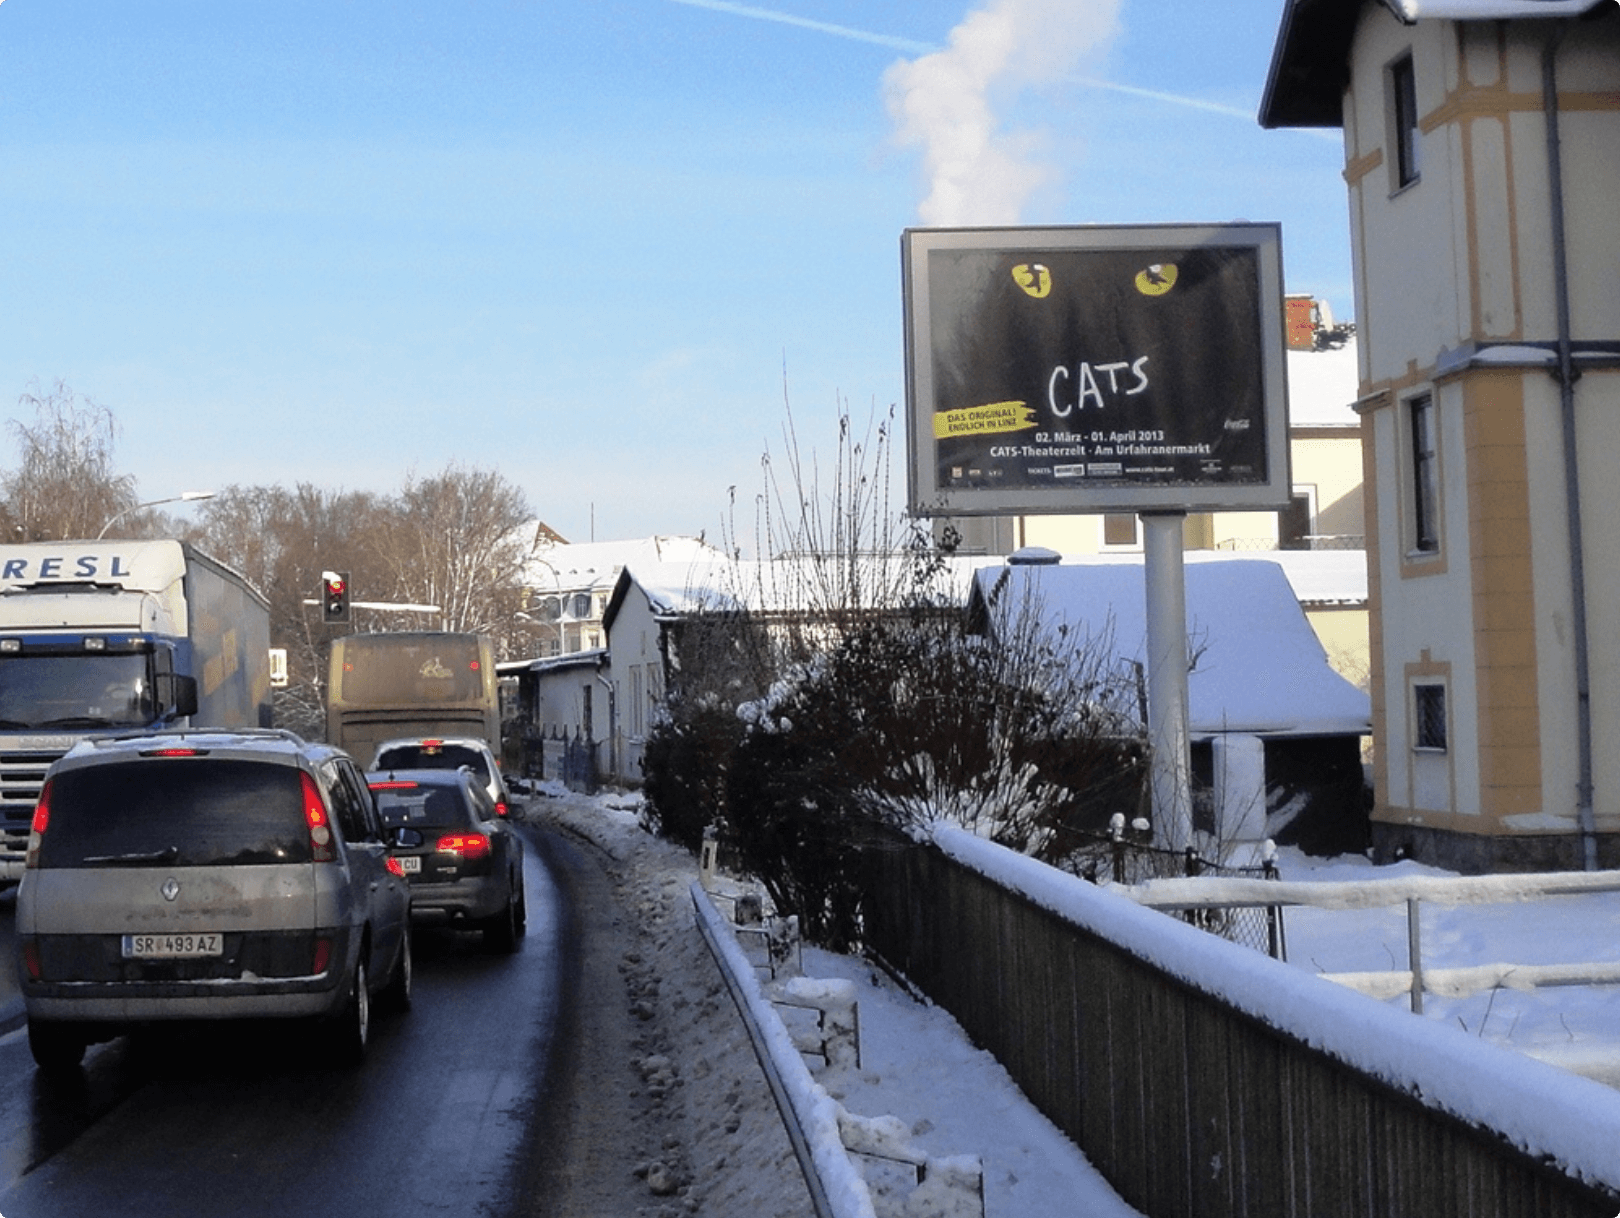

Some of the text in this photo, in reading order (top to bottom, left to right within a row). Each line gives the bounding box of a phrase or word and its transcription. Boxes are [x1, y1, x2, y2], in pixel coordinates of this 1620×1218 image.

[1048, 355, 1149, 417] CATS
[946, 413, 967, 423] DAS
[948, 417, 1017, 433] ENDLICH IN LINZ
[1035, 432, 1051, 443] 02.
[1054, 431, 1082, 443] März
[1091, 432, 1107, 442] 01.
[1109, 429, 1136, 443] April
[1138, 430, 1165, 442] 2013
[990, 445, 1086, 457] CATS-Theaterzelt
[1094, 445, 1114, 455] Am
[1116, 443, 1211, 455] Urfahranermarkt
[404, 859, 418, 870] CU
[135, 936, 217, 953] SR 493 AZ
